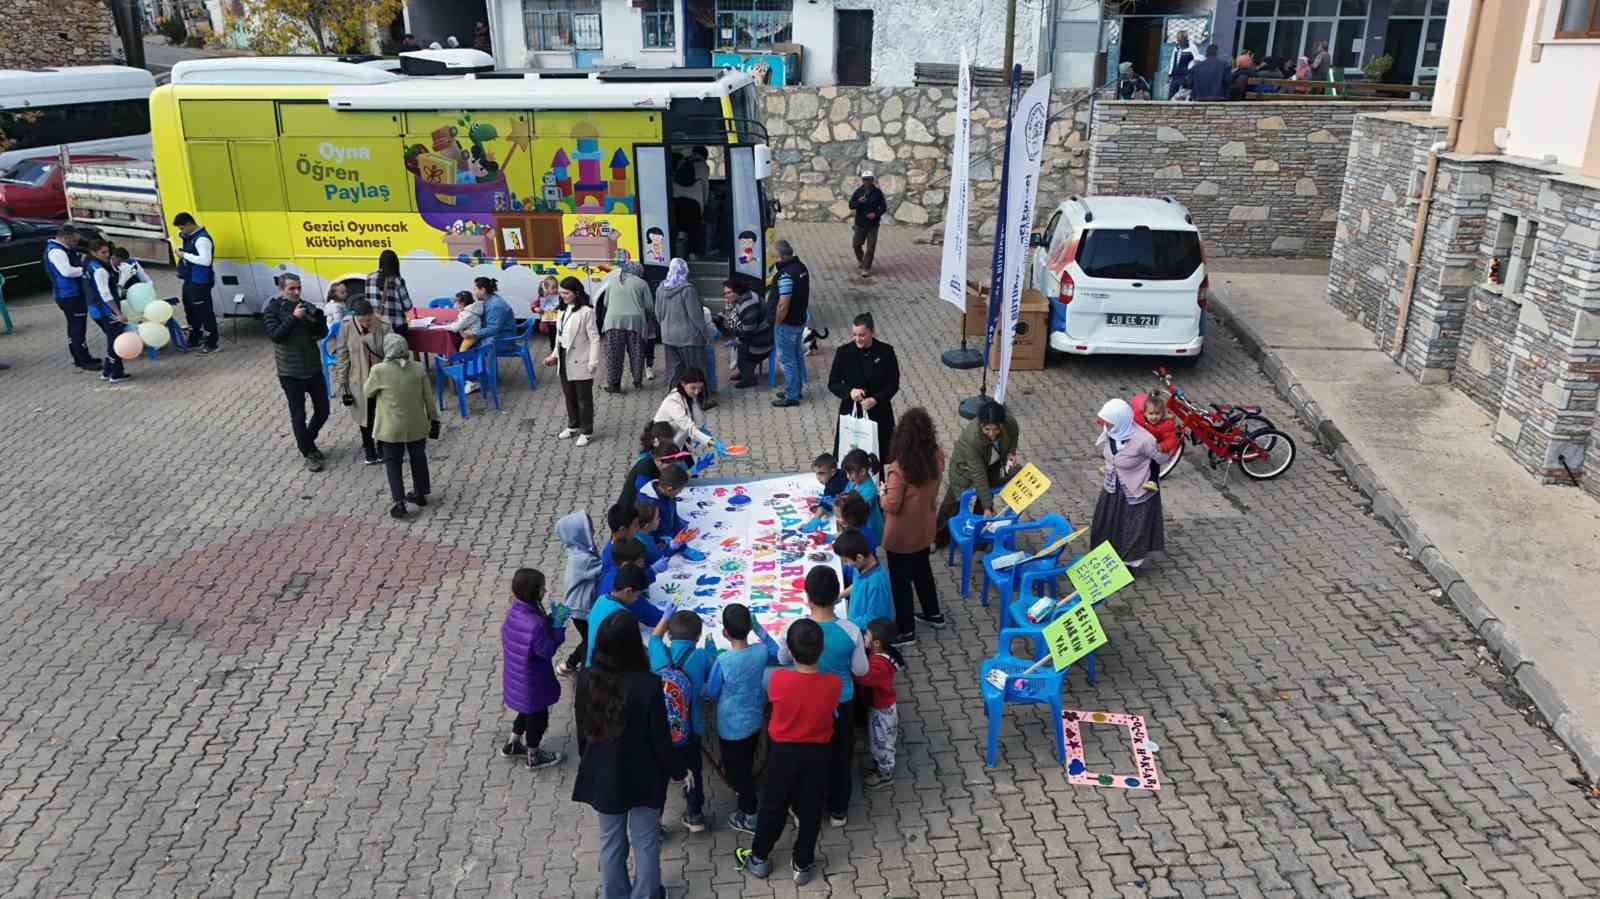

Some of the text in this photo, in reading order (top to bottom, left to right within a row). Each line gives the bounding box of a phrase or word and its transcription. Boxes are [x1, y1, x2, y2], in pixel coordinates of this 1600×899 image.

[319, 143, 371, 164] Oyna
[296, 153, 359, 181] Öğren
[324, 182, 390, 203] Paylaş
[303, 221, 409, 234] Gezici Oyuncak
[305, 237, 392, 250] Kütüphanesi
[1136, 748, 1157, 788] HAKLARI
